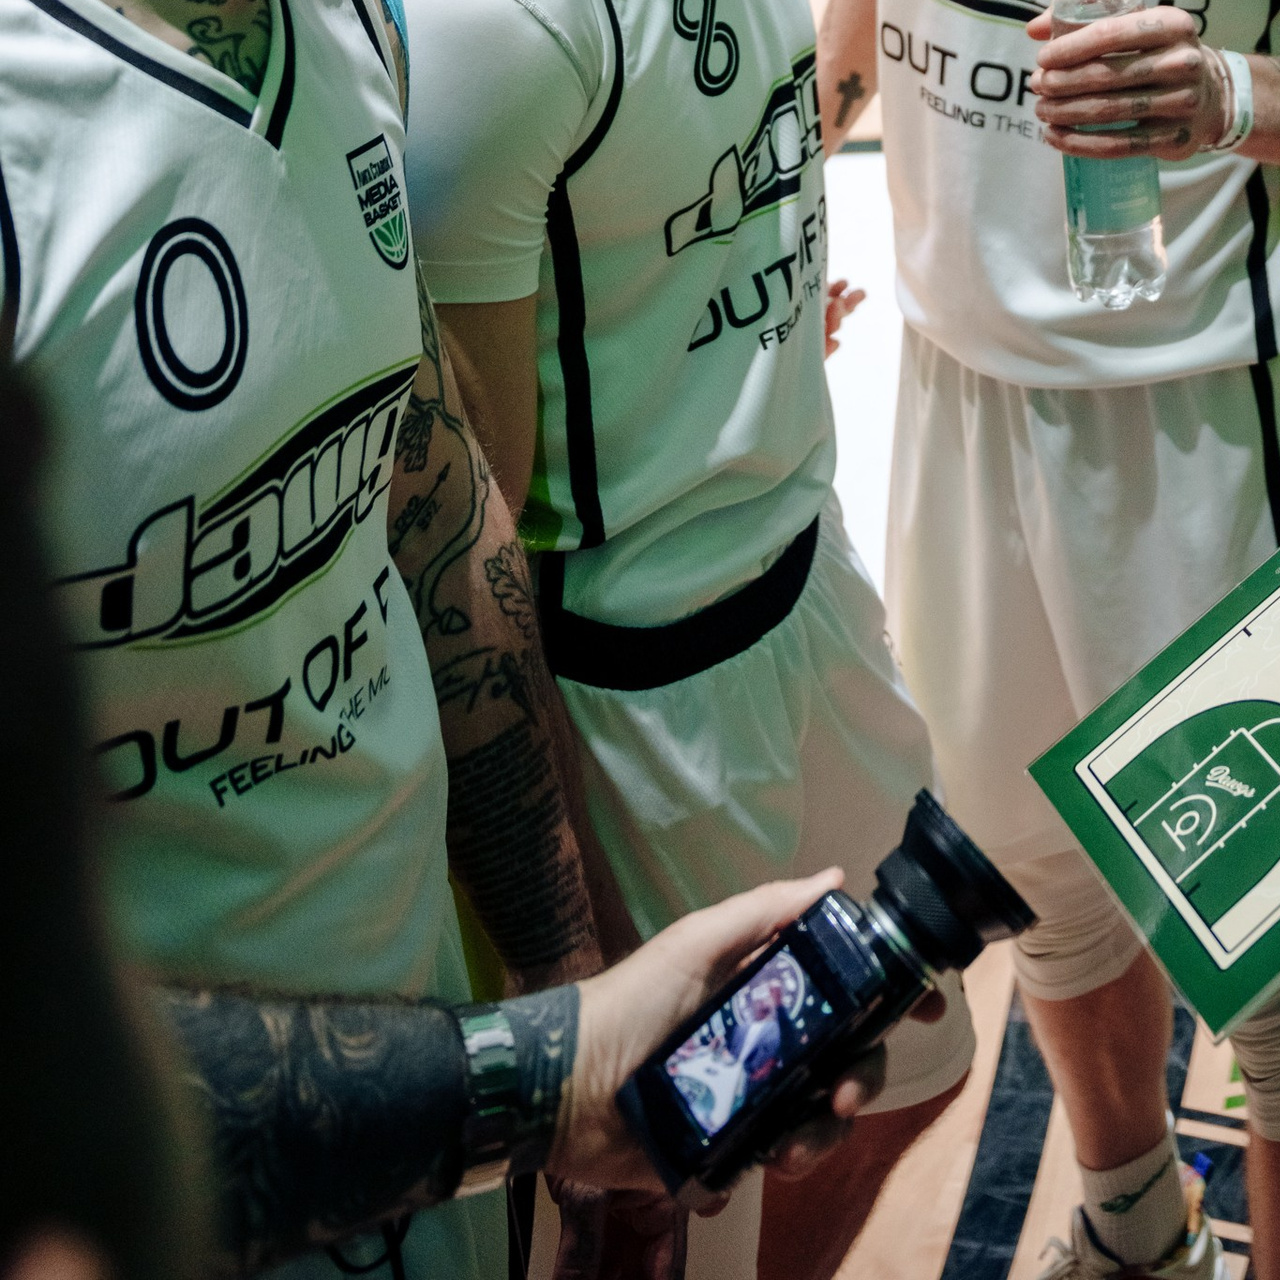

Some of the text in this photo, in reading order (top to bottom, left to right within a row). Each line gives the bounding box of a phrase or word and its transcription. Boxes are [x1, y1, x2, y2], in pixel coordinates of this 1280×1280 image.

[881, 21, 958, 86] OUT
[920, 86, 986, 129] FEELING
[994, 115, 1035, 139] THE
[357, 173, 399, 212] MEDIA
[363, 190, 402, 229] BASKET
[135, 217, 249, 412] 0
[97, 599, 368, 802] OUT OF
[209, 723, 357, 808] FEELING
